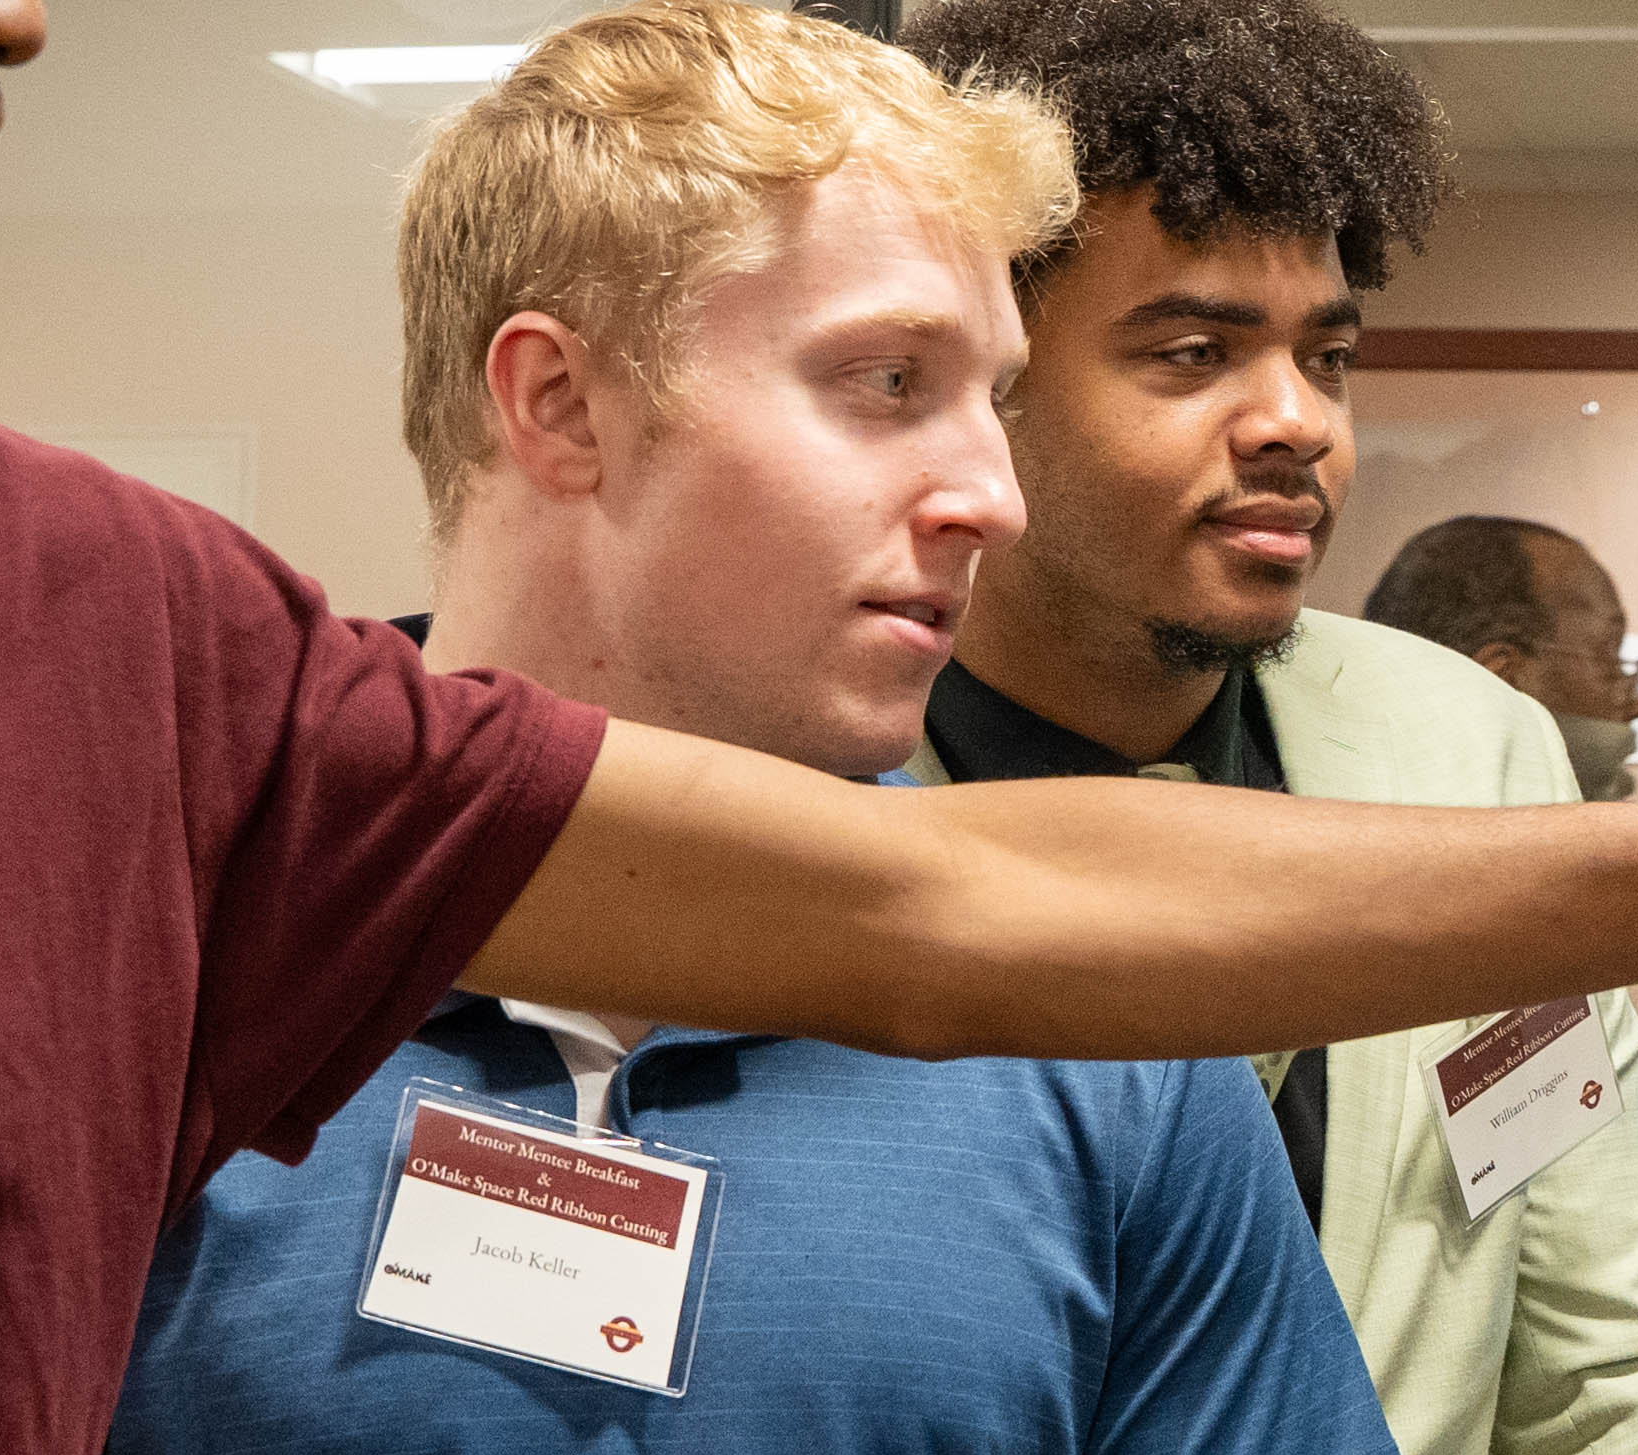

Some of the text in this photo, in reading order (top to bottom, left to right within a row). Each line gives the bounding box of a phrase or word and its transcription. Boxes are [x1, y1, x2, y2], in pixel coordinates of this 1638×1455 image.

[1463, 1040, 1493, 1063] Mentor
[1483, 1063, 1505, 1085] Space
[1505, 1051, 1524, 1069] Red
[1522, 1031, 1554, 1057] Ribbon
[1553, 1007, 1586, 1034] Cutting
[1490, 1070, 1569, 1129] William Driggins
[459, 1126, 641, 1190] Mentor Mentee Breakfast
[537, 1172, 553, 1187] &
[411, 1157, 670, 1245] O'Make Space Red Ribbon Cutting
[470, 1236, 581, 1280] Jacob Keller
